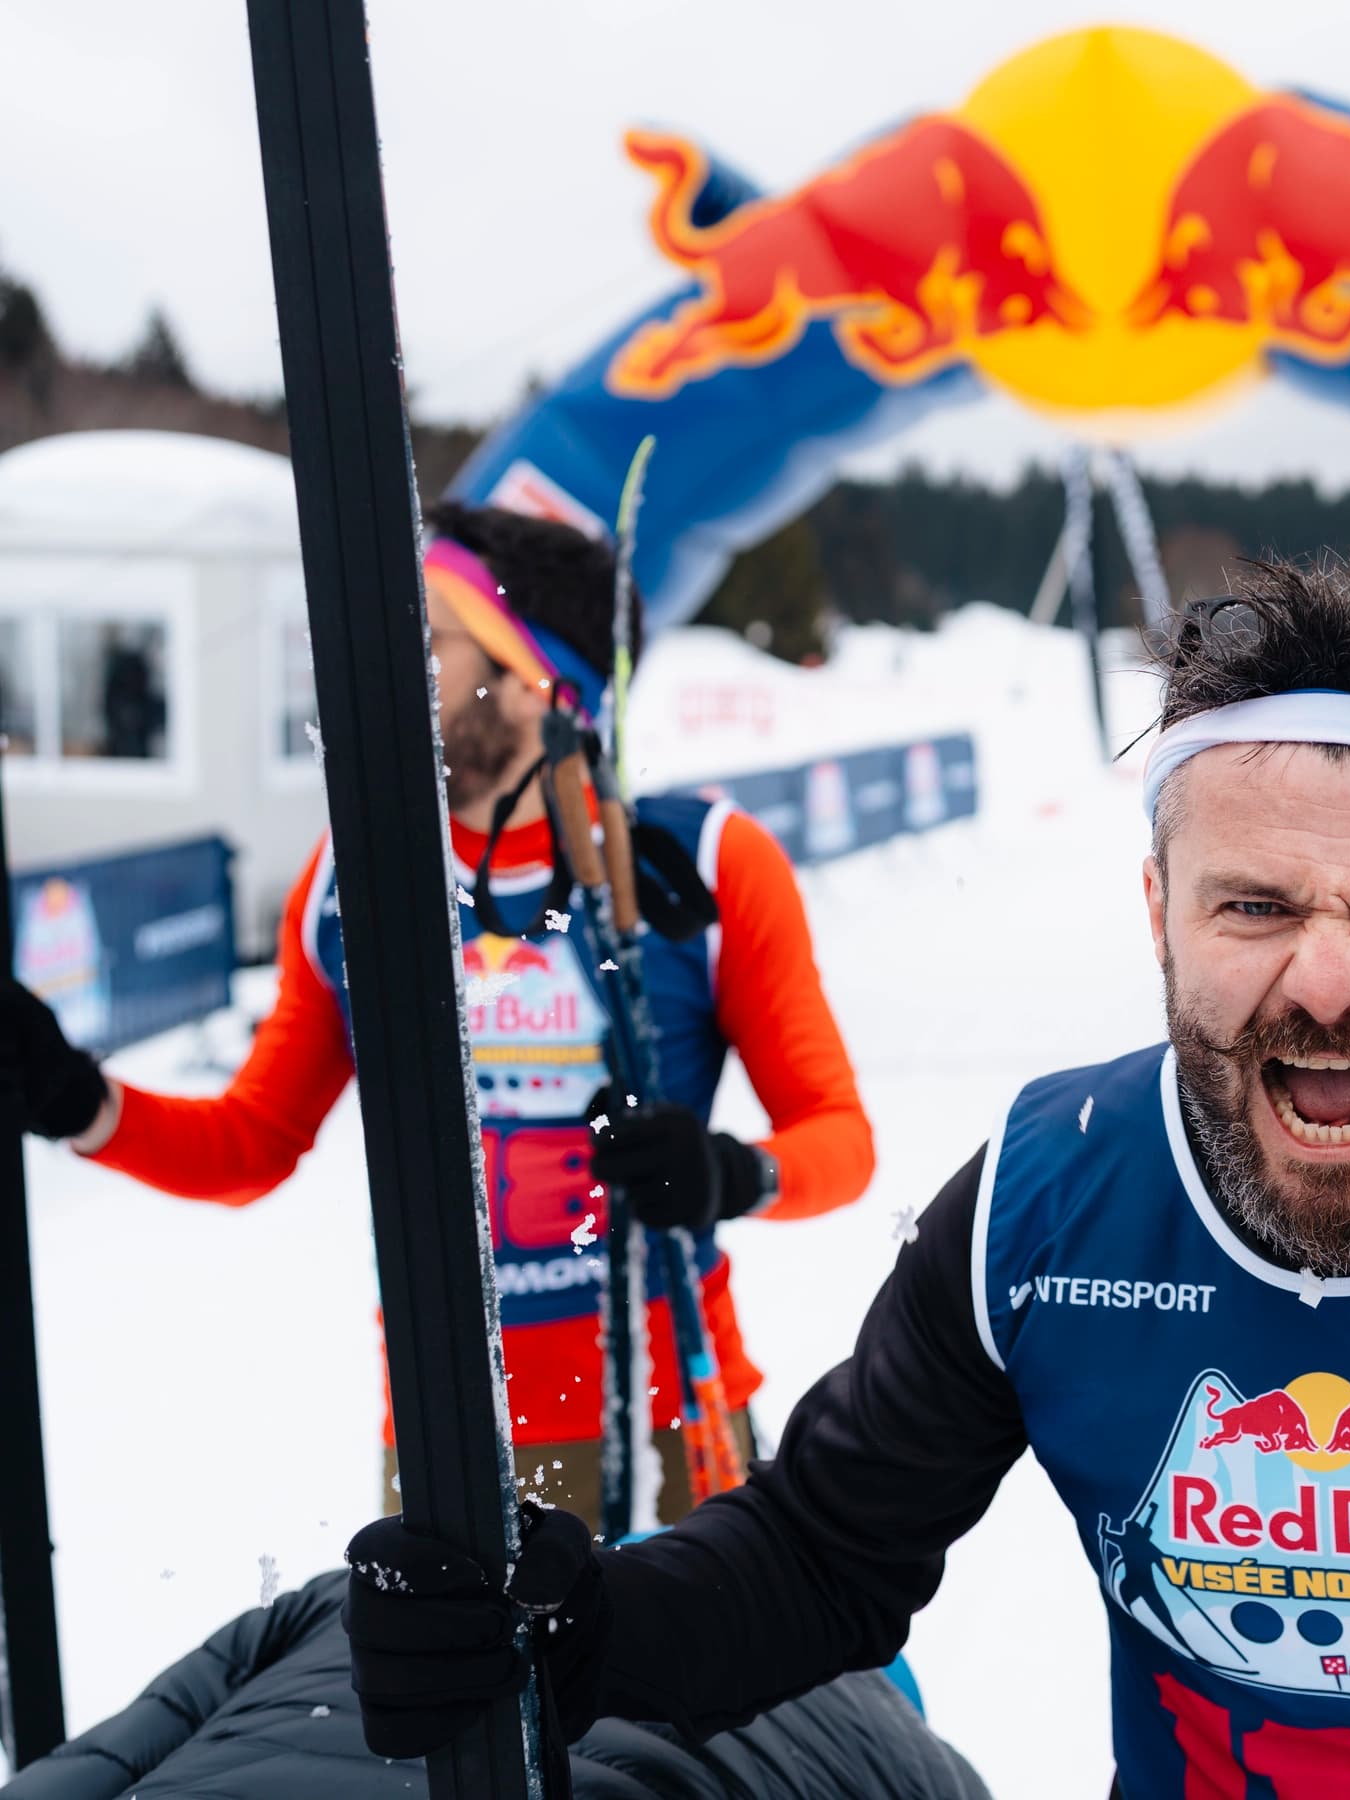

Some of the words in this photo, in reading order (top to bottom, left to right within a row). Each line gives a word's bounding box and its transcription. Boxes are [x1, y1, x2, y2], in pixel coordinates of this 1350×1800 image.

[495, 993, 577, 1034] Bull
[1173, 1475, 1318, 1552] Red
[1161, 1558, 1287, 1597] VISÉE
